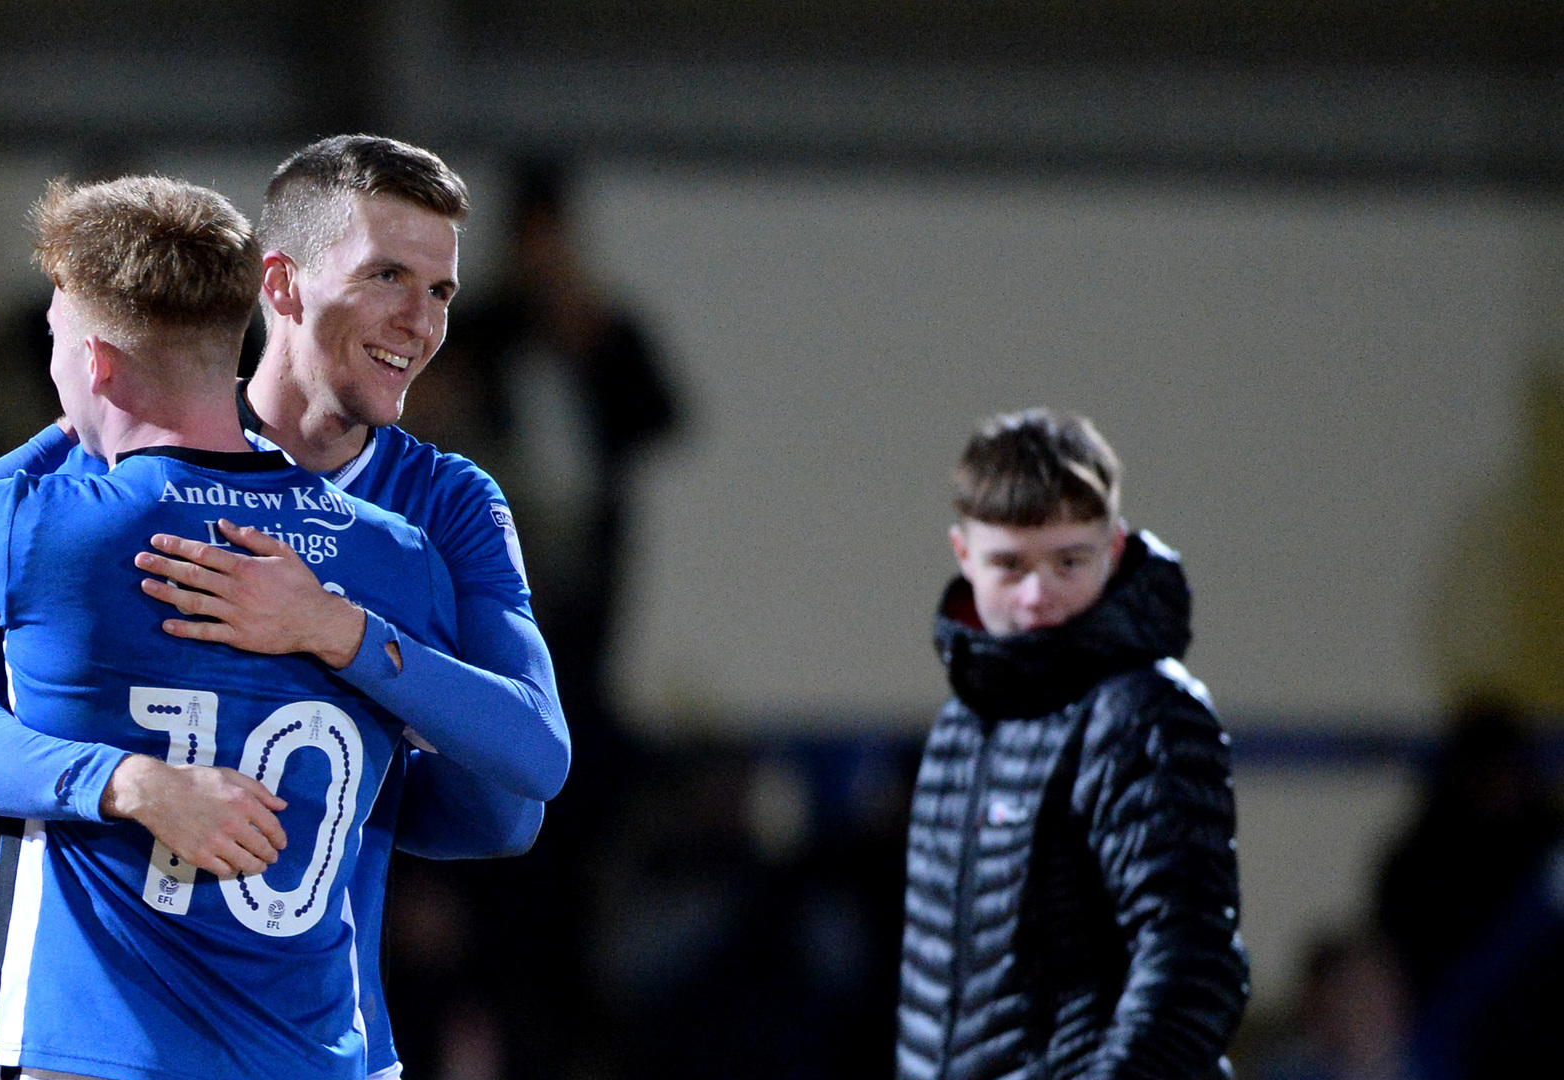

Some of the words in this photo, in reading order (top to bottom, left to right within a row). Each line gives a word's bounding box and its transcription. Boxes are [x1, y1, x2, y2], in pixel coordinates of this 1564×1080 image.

[159, 481, 283, 510] Andrew
[290, 486, 357, 525] Kelly
[203, 520, 338, 564] Lings
[129, 686, 364, 937] 10
[157, 895, 174, 906] EFL
[266, 919, 280, 930] EFL
